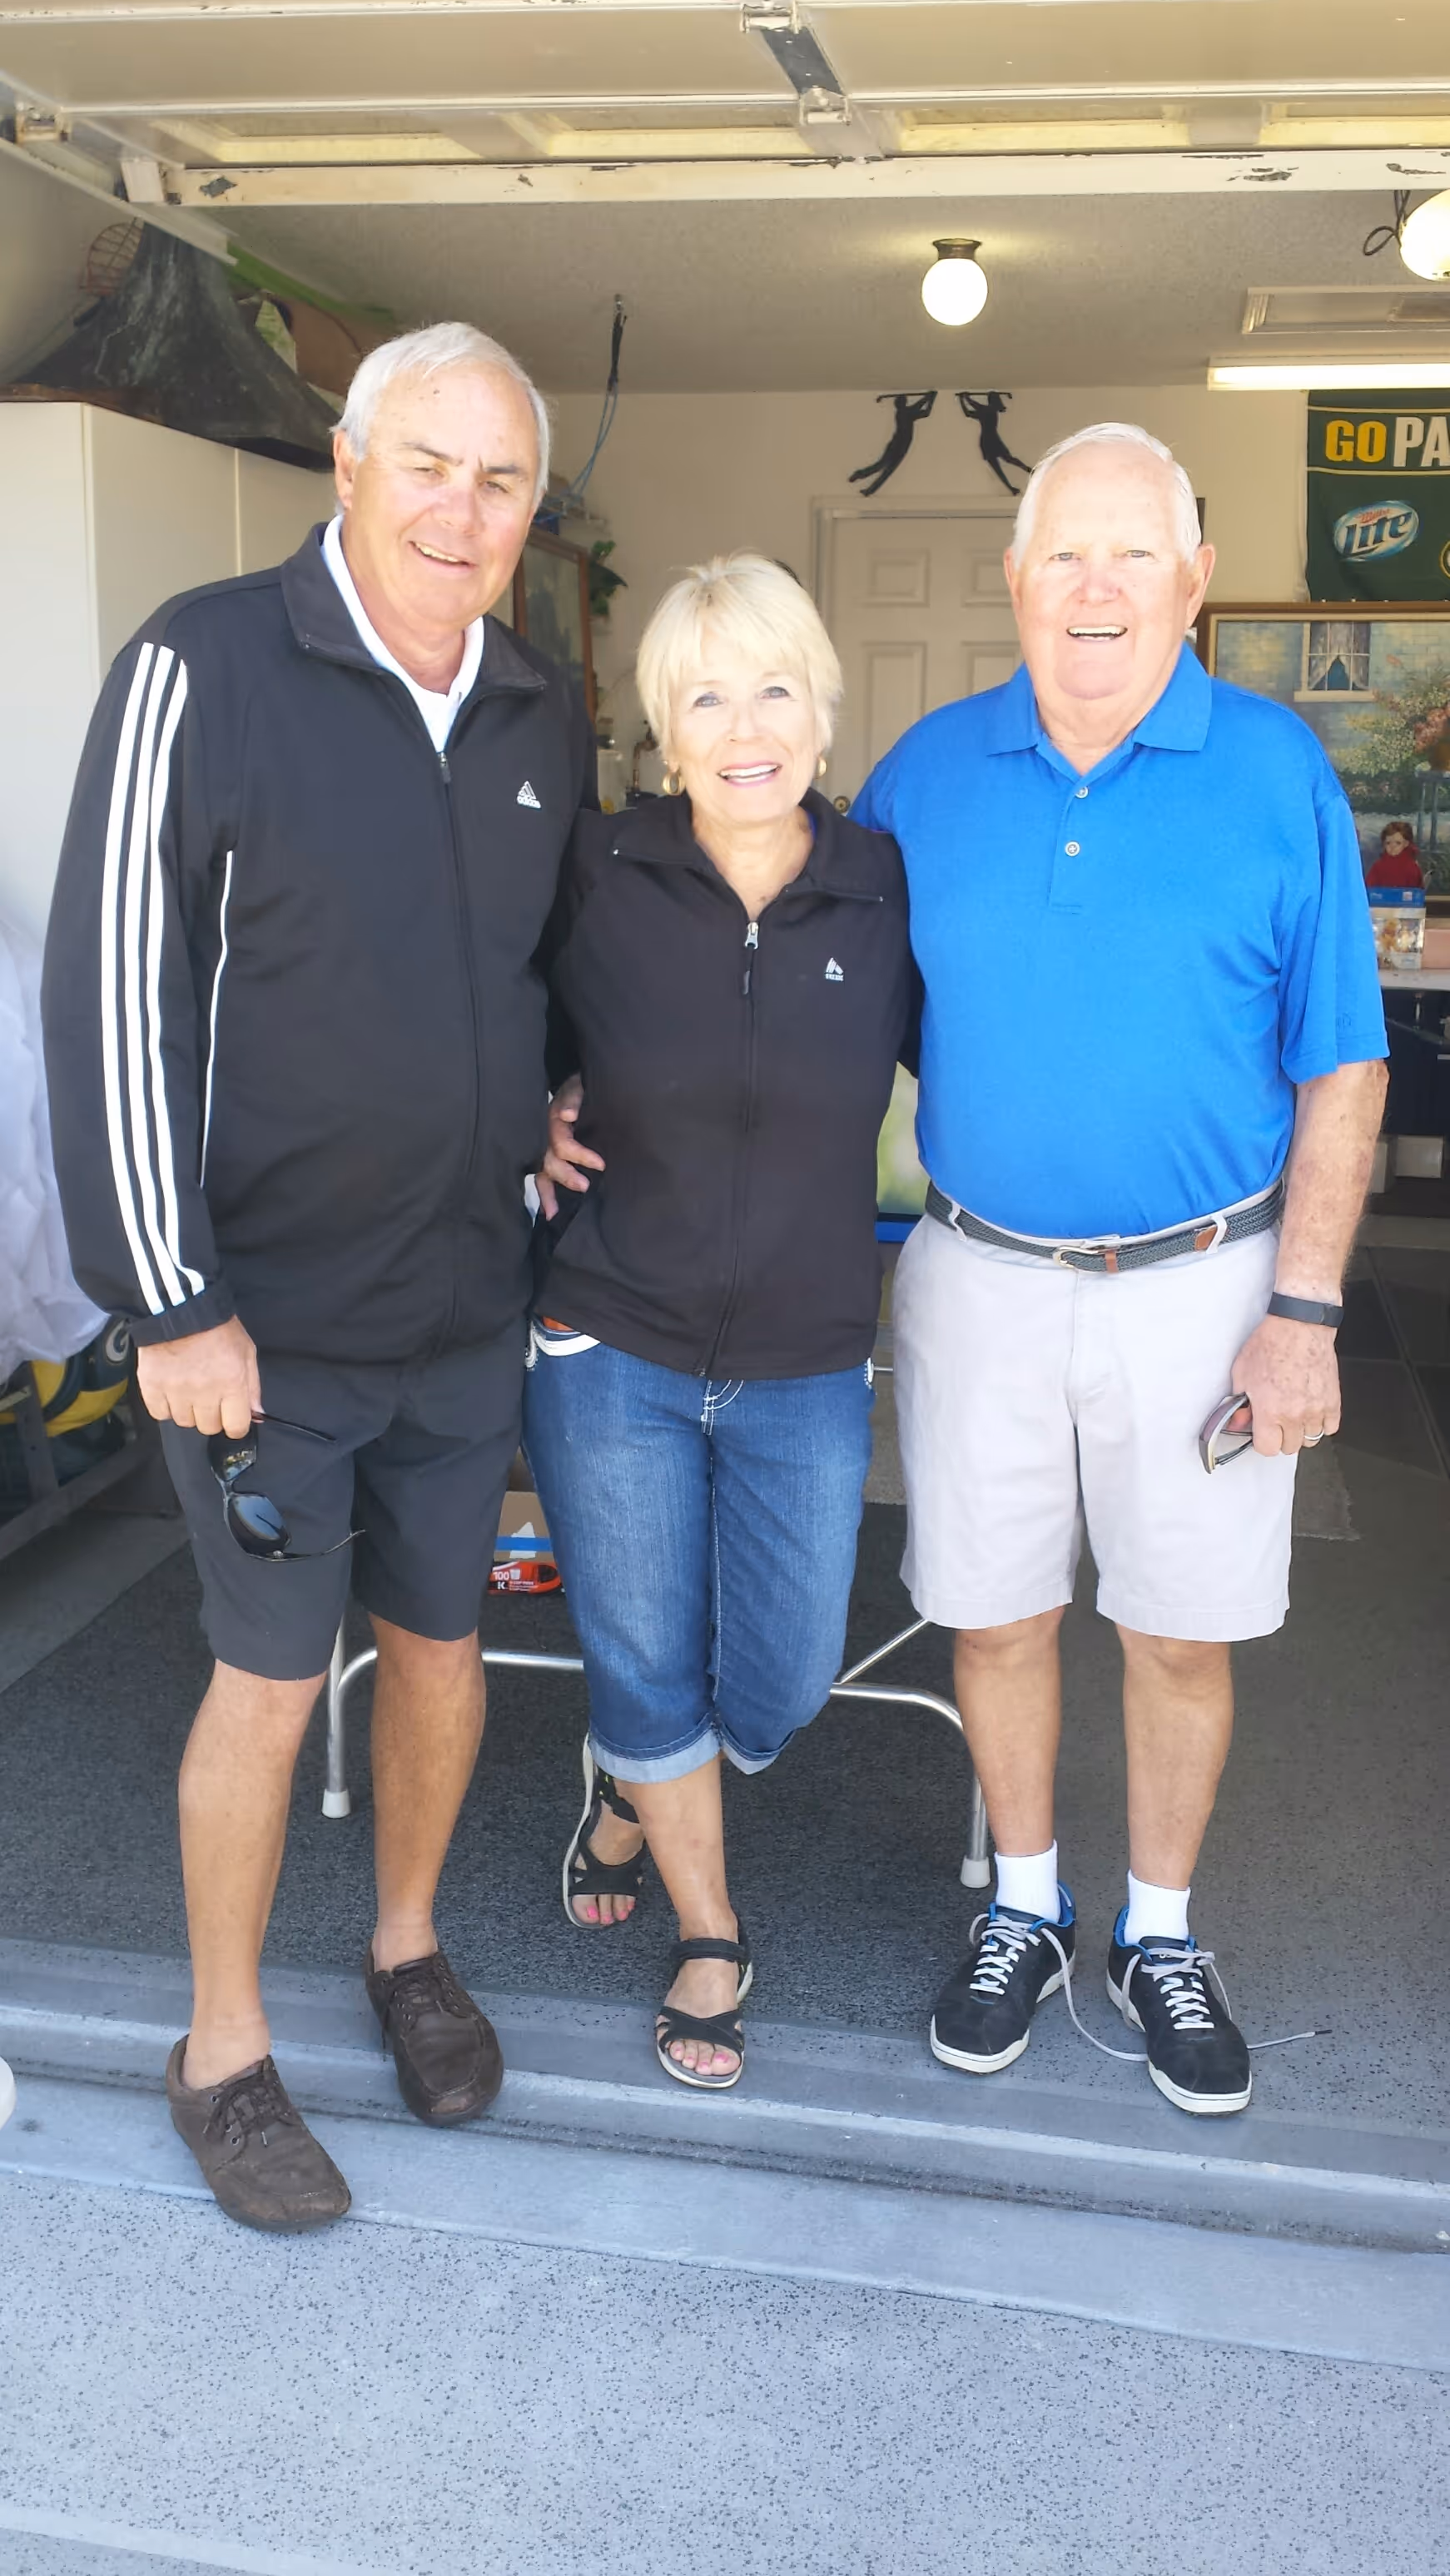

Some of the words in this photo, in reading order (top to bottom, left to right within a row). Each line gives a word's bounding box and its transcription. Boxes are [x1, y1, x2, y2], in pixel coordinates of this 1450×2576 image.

[1325, 419, 1387, 463] GO
[1342, 511, 1413, 556] Lite
[493, 1571, 509, 1581] 100
[497, 1581, 505, 1590] K
